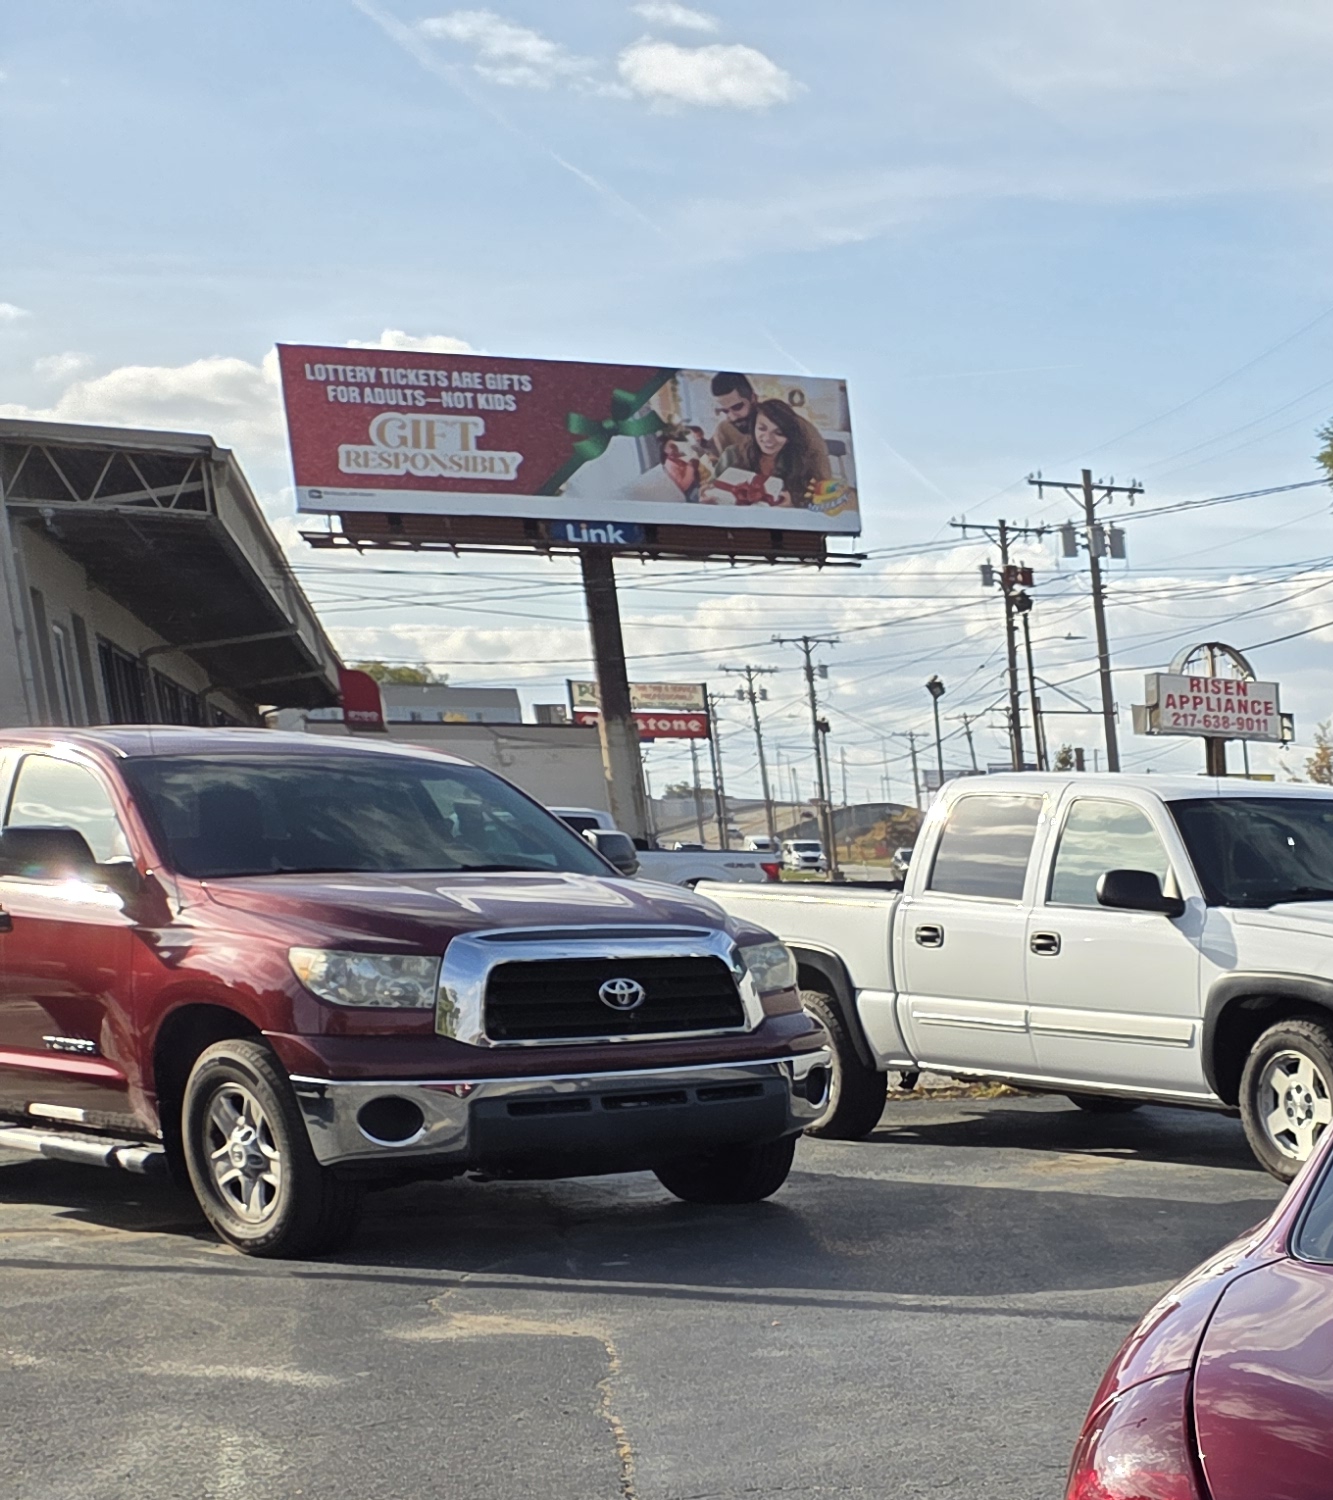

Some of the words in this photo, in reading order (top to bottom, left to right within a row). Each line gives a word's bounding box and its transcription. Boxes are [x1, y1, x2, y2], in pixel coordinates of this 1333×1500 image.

[305, 363, 376, 383] LOTTERY
[379, 367, 448, 387] TICKETS
[451, 371, 483, 389] ARE
[485, 373, 532, 392] GIFTS
[327, 385, 363, 403] FOR
[477, 394, 518, 411] KIDS
[376, 416, 480, 451] GIFT
[344, 449, 518, 475] RESPONSIBLY
[566, 523, 627, 544] Link
[1189, 677, 1248, 697] RISEN
[1165, 693, 1275, 717] APPLIANCE
[1171, 712, 1269, 732] 217-638-9011
